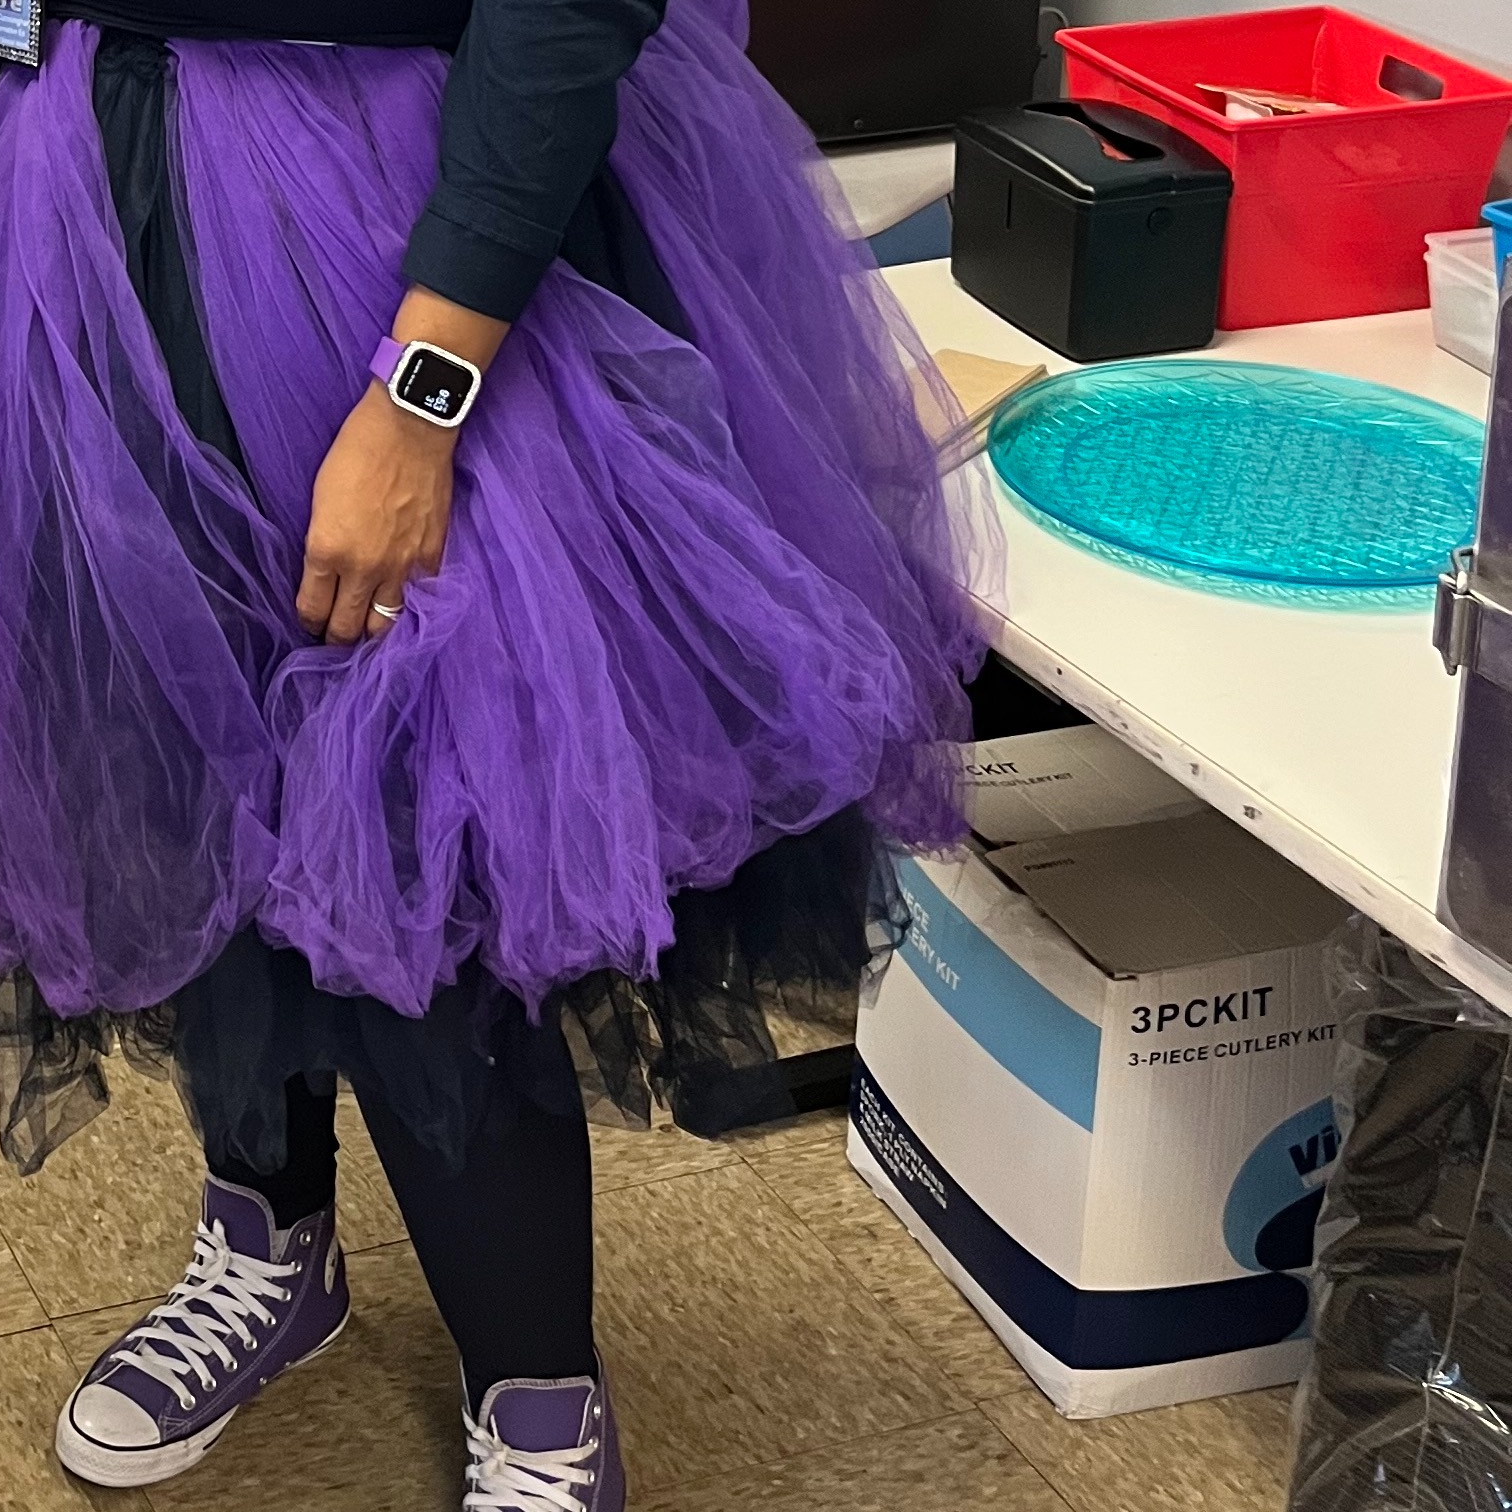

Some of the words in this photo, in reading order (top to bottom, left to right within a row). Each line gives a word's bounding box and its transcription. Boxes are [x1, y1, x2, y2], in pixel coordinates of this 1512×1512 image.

[935, 956, 961, 991] KIT
[1131, 986, 1273, 1034] 3PCKIT
[1128, 1045, 1209, 1067] 3-PIECE
[1214, 1030, 1303, 1058] CUTLERY
[1307, 1023, 1338, 1043] KIT
